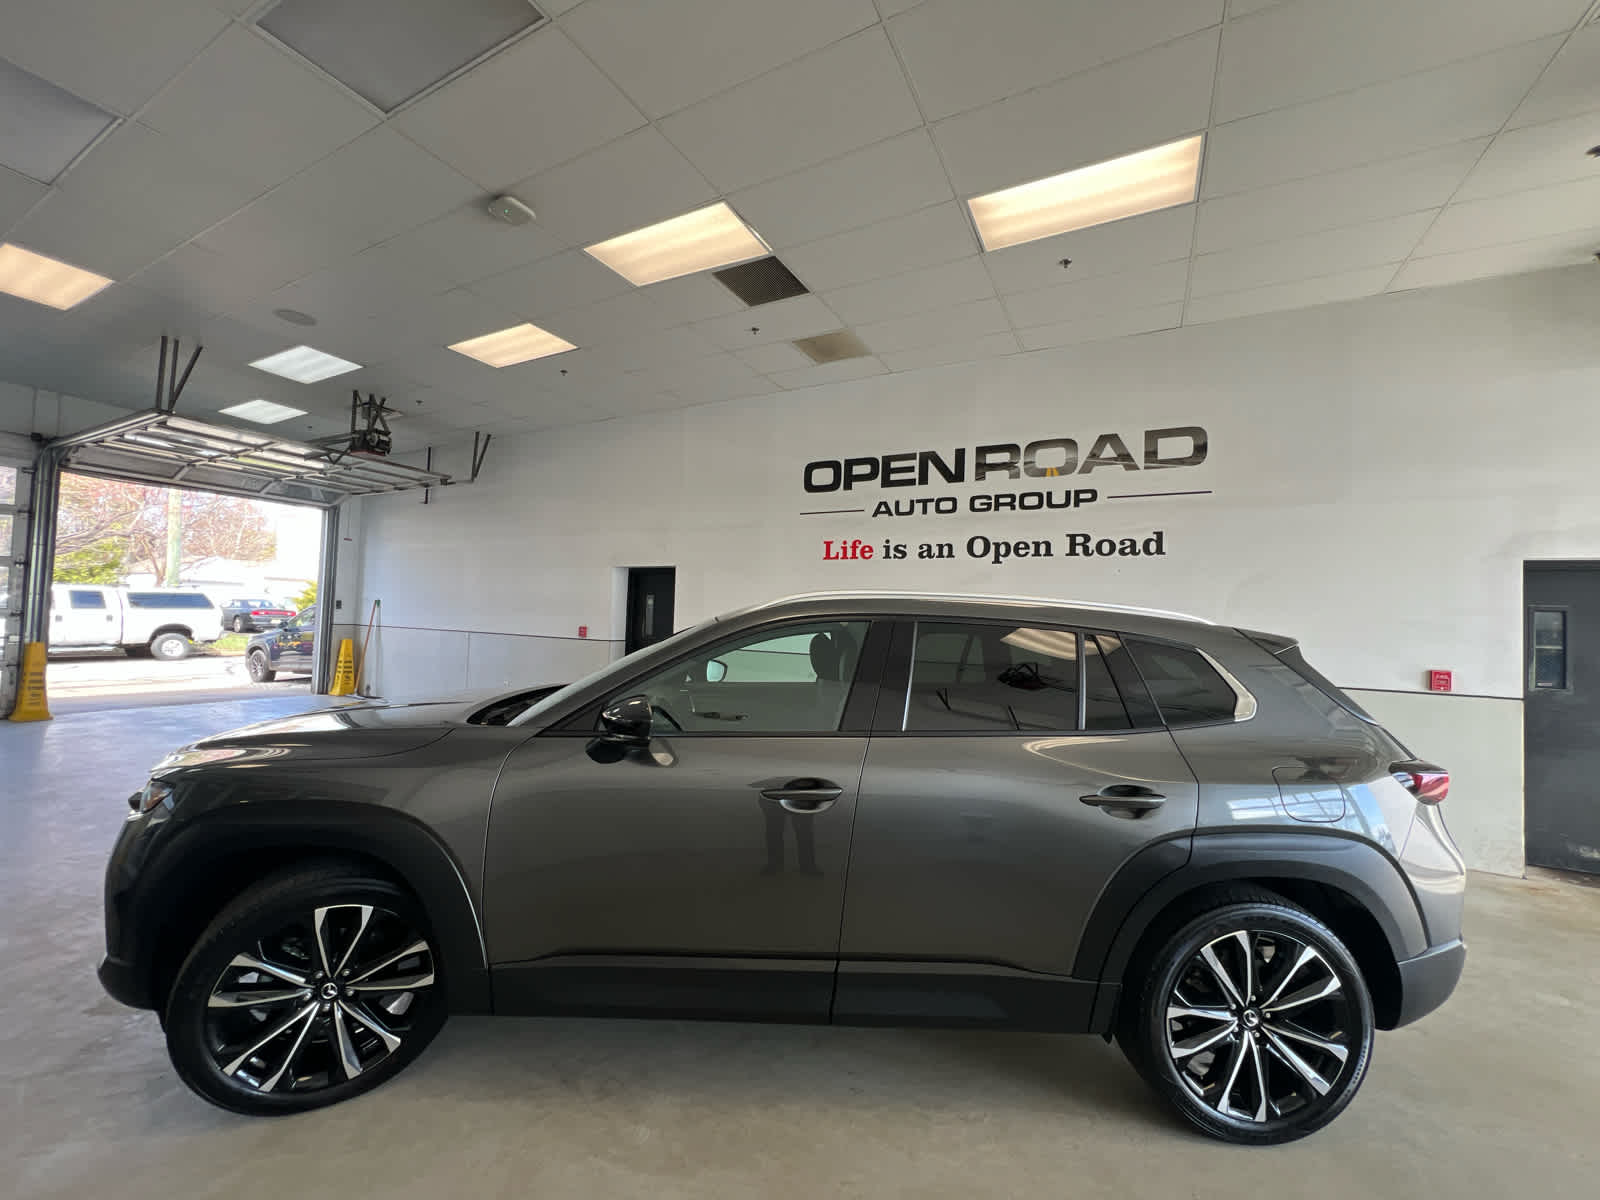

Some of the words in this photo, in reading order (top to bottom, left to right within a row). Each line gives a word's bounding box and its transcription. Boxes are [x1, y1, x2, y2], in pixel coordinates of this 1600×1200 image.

[871, 496, 958, 518] AUTO
[968, 488, 1098, 513] GROUP
[822, 540, 874, 561] Life
[882, 539, 908, 560] is
[917, 542, 956, 560] an
[966, 535, 1054, 565] Open
[1064, 531, 1166, 557] Road
